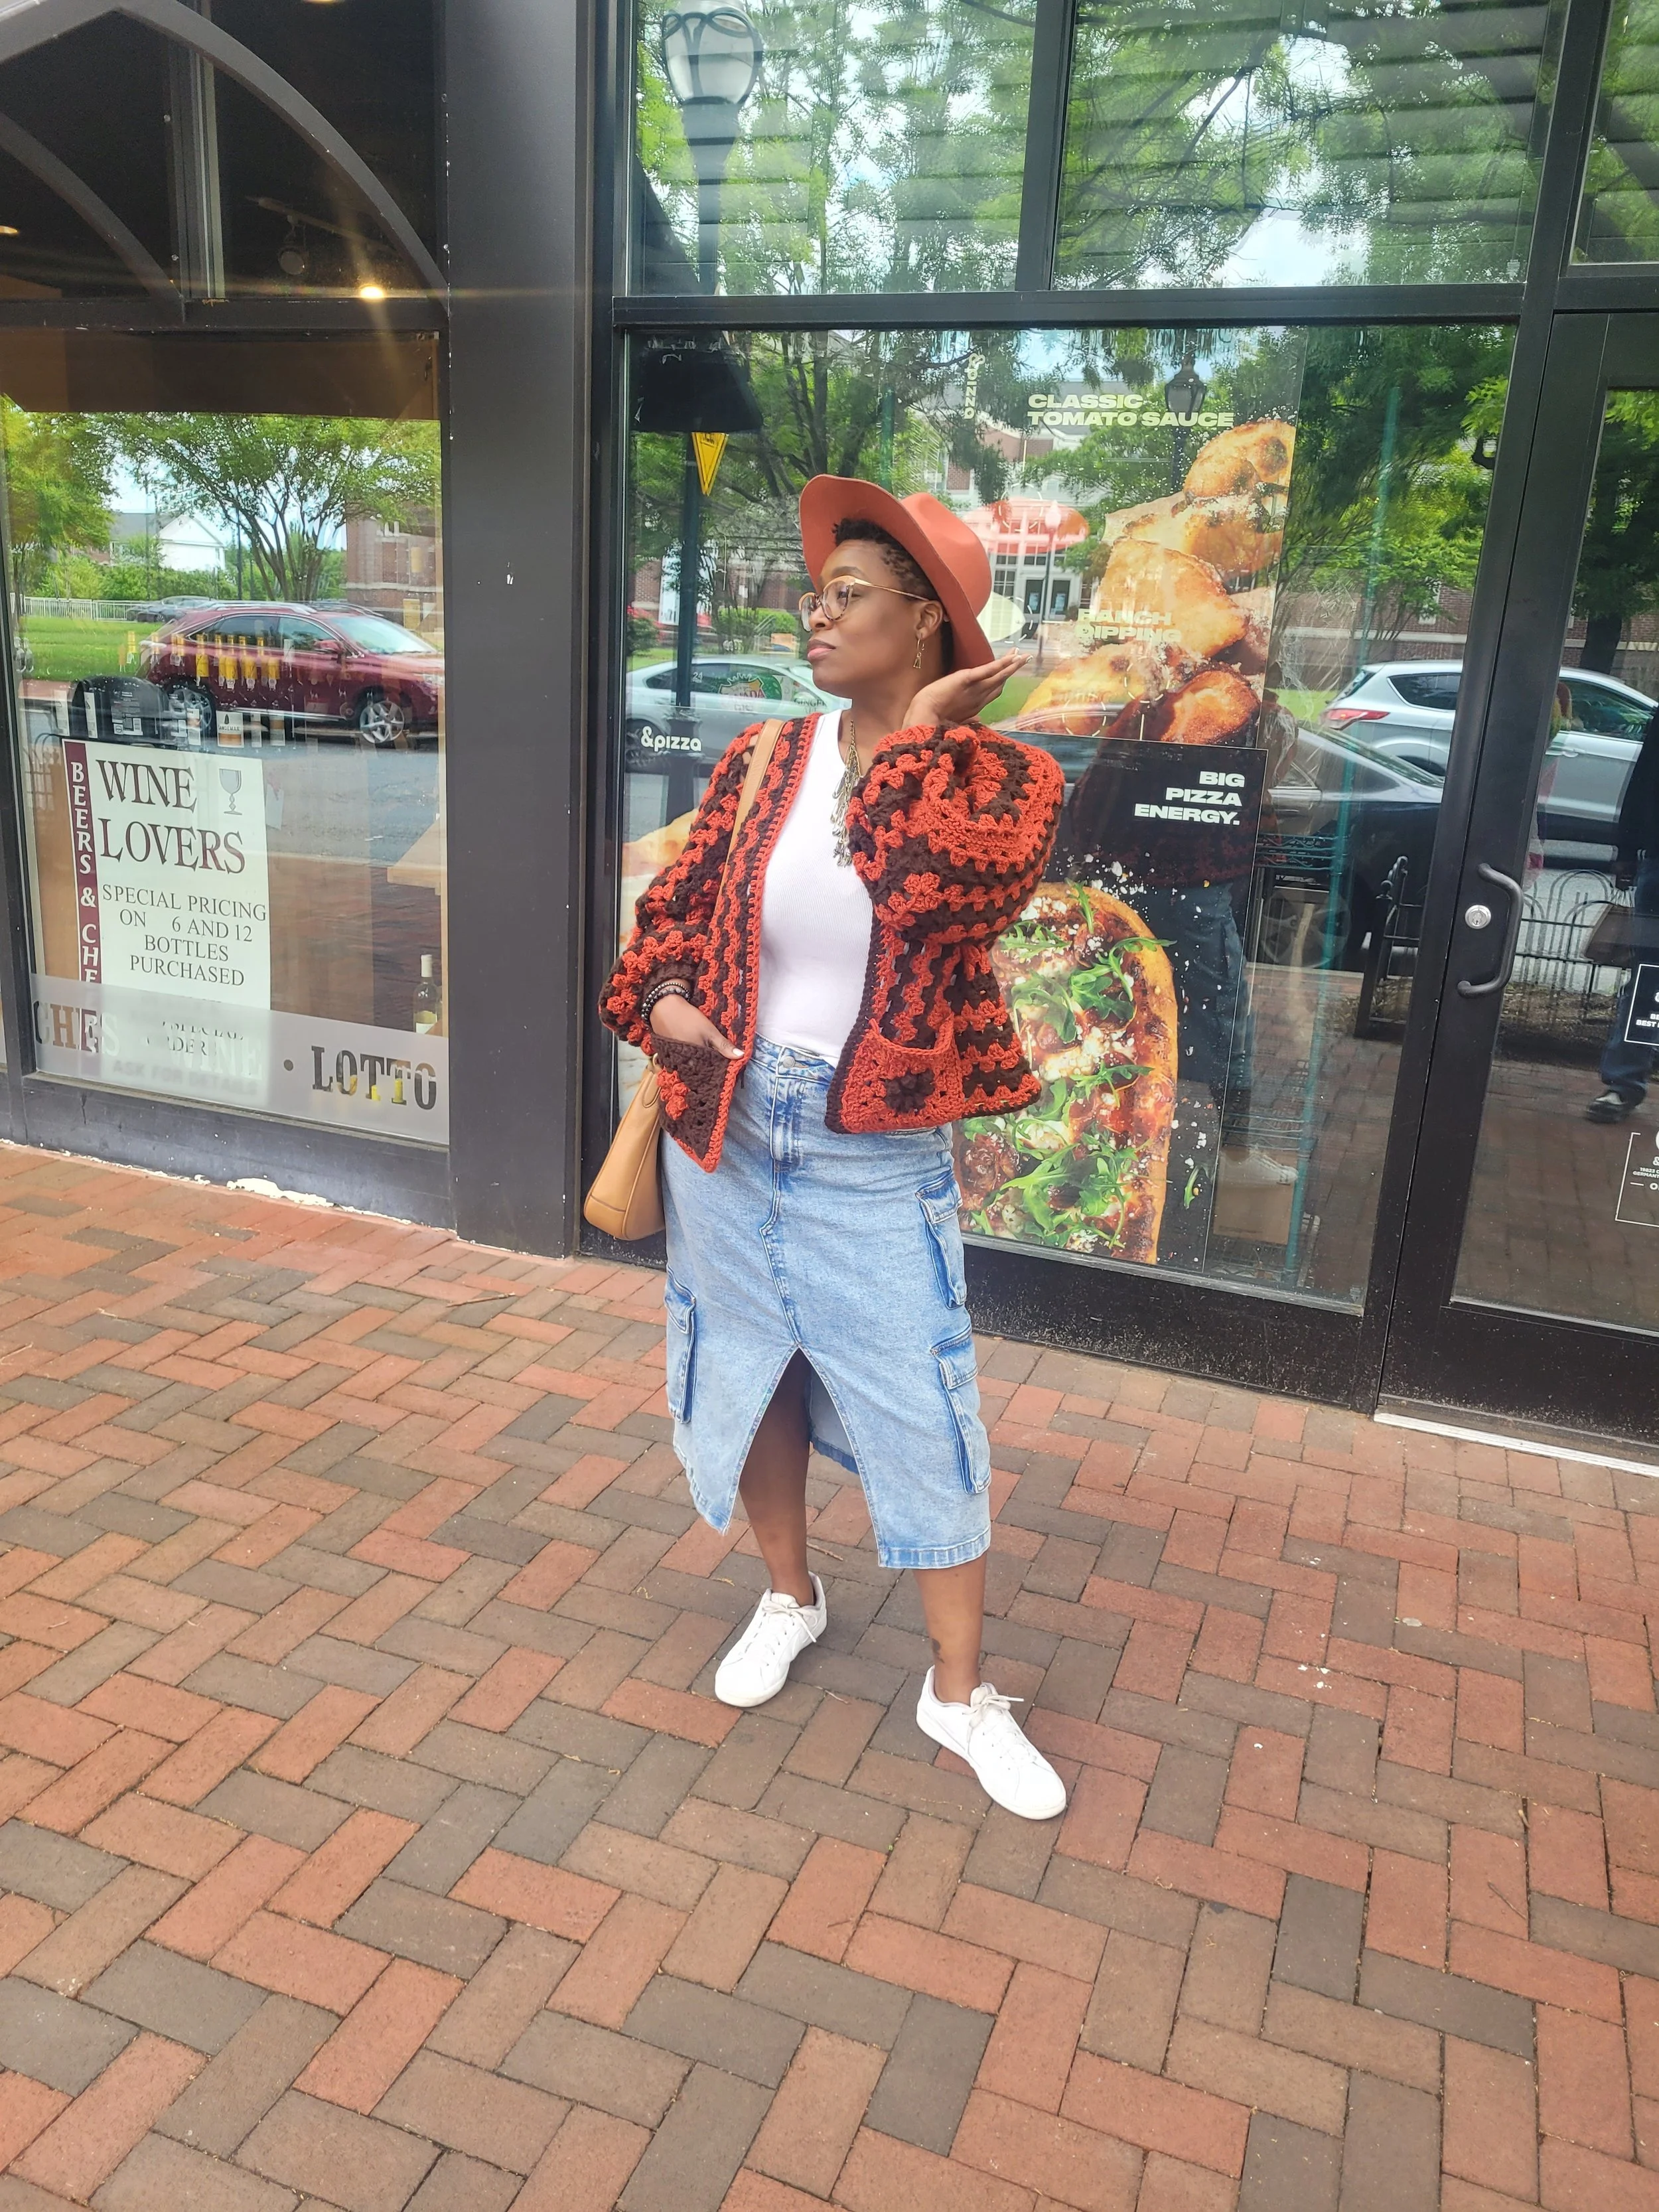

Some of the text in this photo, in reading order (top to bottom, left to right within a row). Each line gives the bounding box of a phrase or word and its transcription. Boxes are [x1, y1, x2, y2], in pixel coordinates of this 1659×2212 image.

[964, 352, 986, 419] &pizza
[1028, 394, 1143, 409] CLASSIC
[1027, 411, 1234, 427] TOMATO SAUCE
[1078, 608, 1173, 625] RANCH
[1075, 625, 1182, 642] DIPPING
[641, 725, 701, 752] &pizza
[96, 759, 197, 813] WINE
[1199, 771, 1246, 788] BIG
[1165, 787, 1243, 806] PIZZA
[71, 761, 93, 874] BEERS
[1134, 803, 1240, 826] ENERGY.
[98, 818, 245, 874] LOVERS
[80, 887, 96, 908] &
[102, 884, 267, 921] SPECIAL PRICING
[119, 909, 253, 942] ON 6 AND 12
[145, 934, 229, 962] BOTTLES
[130, 955, 245, 986] PURCHASED
[311, 1045, 437, 1110] LOTTO
